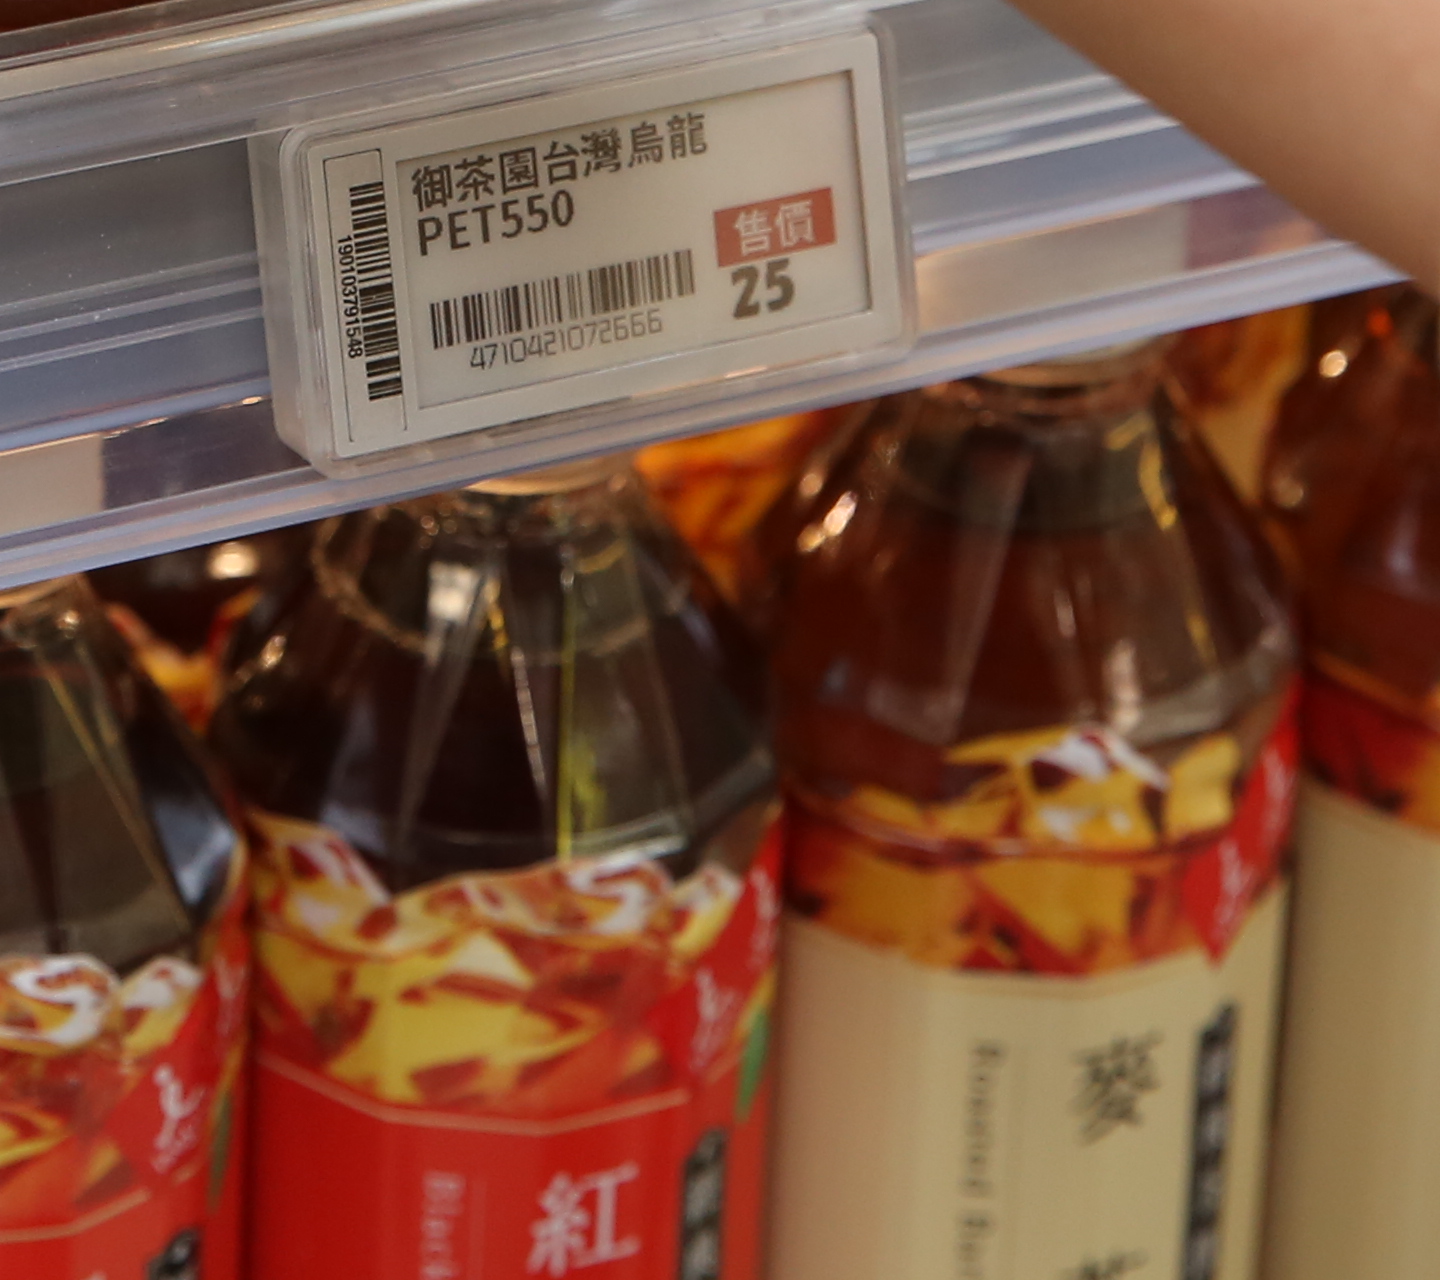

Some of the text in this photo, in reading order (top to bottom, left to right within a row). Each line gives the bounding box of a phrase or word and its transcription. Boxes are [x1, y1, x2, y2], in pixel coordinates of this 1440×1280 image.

[410, 111, 708, 214] 御茶園台灣烏龍
[418, 189, 575, 257] PET550
[733, 199, 815, 257] 售價
[337, 234, 364, 360] 190103791548
[730, 257, 796, 320] 25
[469, 309, 663, 372] 4710421072666
[525, 1161, 641, 1279] 紅
